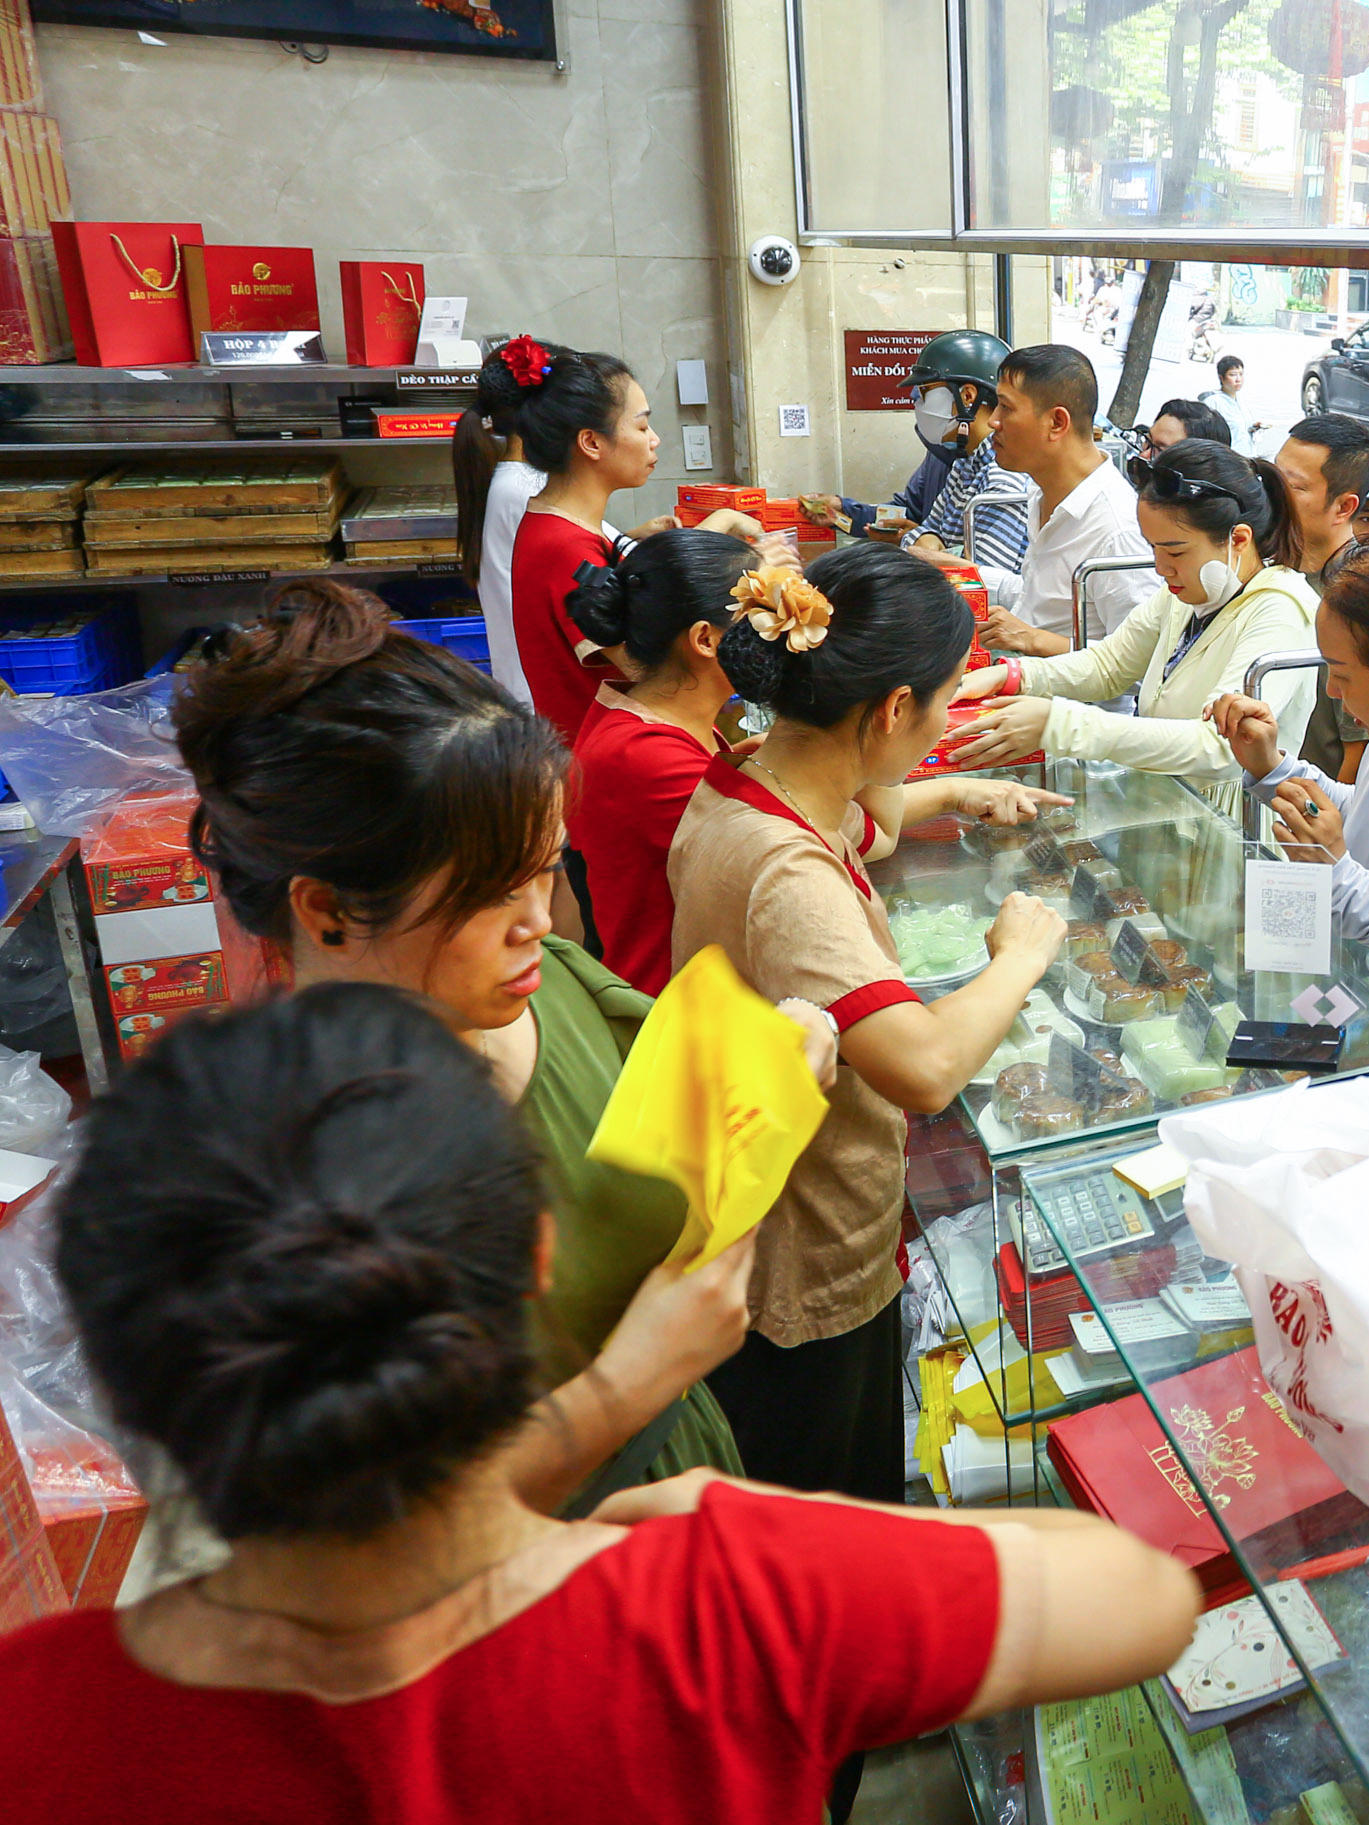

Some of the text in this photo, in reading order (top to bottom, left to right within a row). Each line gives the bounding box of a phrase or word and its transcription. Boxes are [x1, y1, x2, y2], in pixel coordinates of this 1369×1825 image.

[230, 281, 251, 296] BẢO
[223, 338, 254, 351] HỘP
[867, 335, 890, 344] HÀNG
[891, 336, 913, 345] THỰC
[860, 346, 888, 355] KHÁCH
[889, 347, 908, 355] MUA
[852, 362, 882, 376] MIỄN
[428, 374, 460, 386] THẬP
[462, 373, 479, 384] CẨ
[881, 396, 894, 405] Xin
[237, 570, 267, 582] XANH
